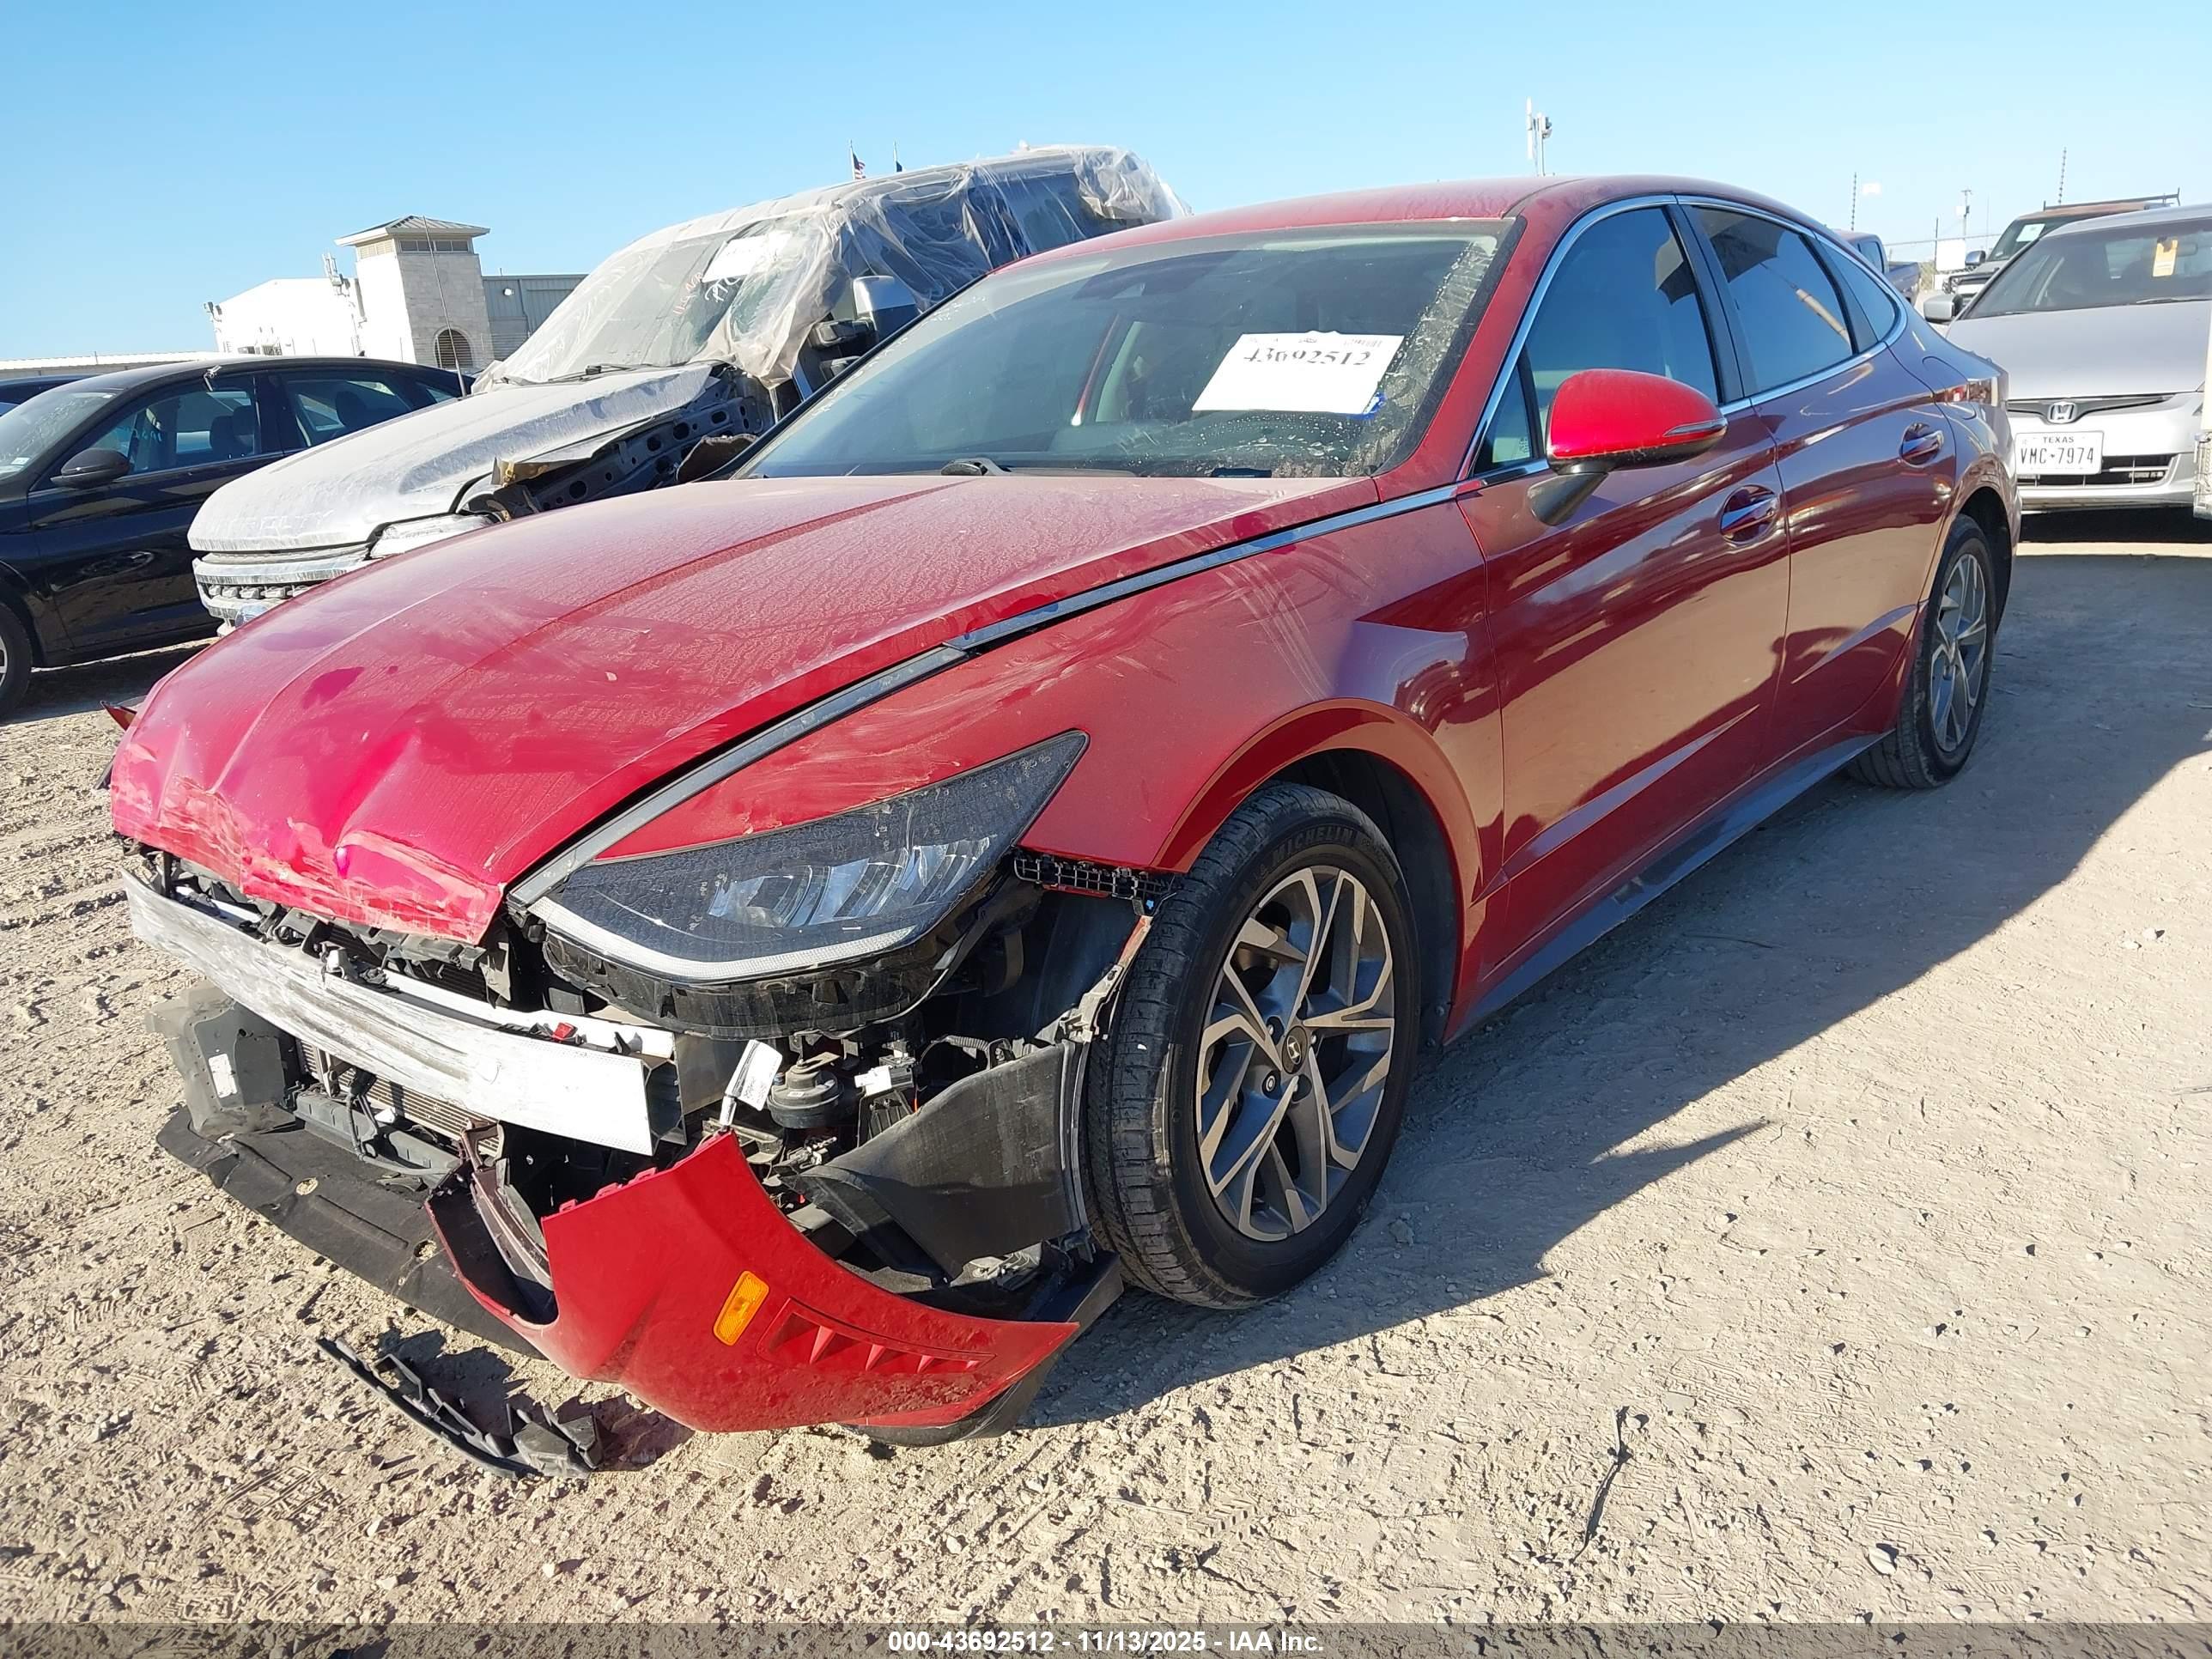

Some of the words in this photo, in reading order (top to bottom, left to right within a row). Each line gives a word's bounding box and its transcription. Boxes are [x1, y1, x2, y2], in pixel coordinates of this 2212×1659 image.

[2042, 435, 2075, 444] TEXAS
[2021, 447, 2047, 465] VMC
[2057, 447, 2094, 465] 7974
[1272, 825, 1354, 866] MICHELIN
